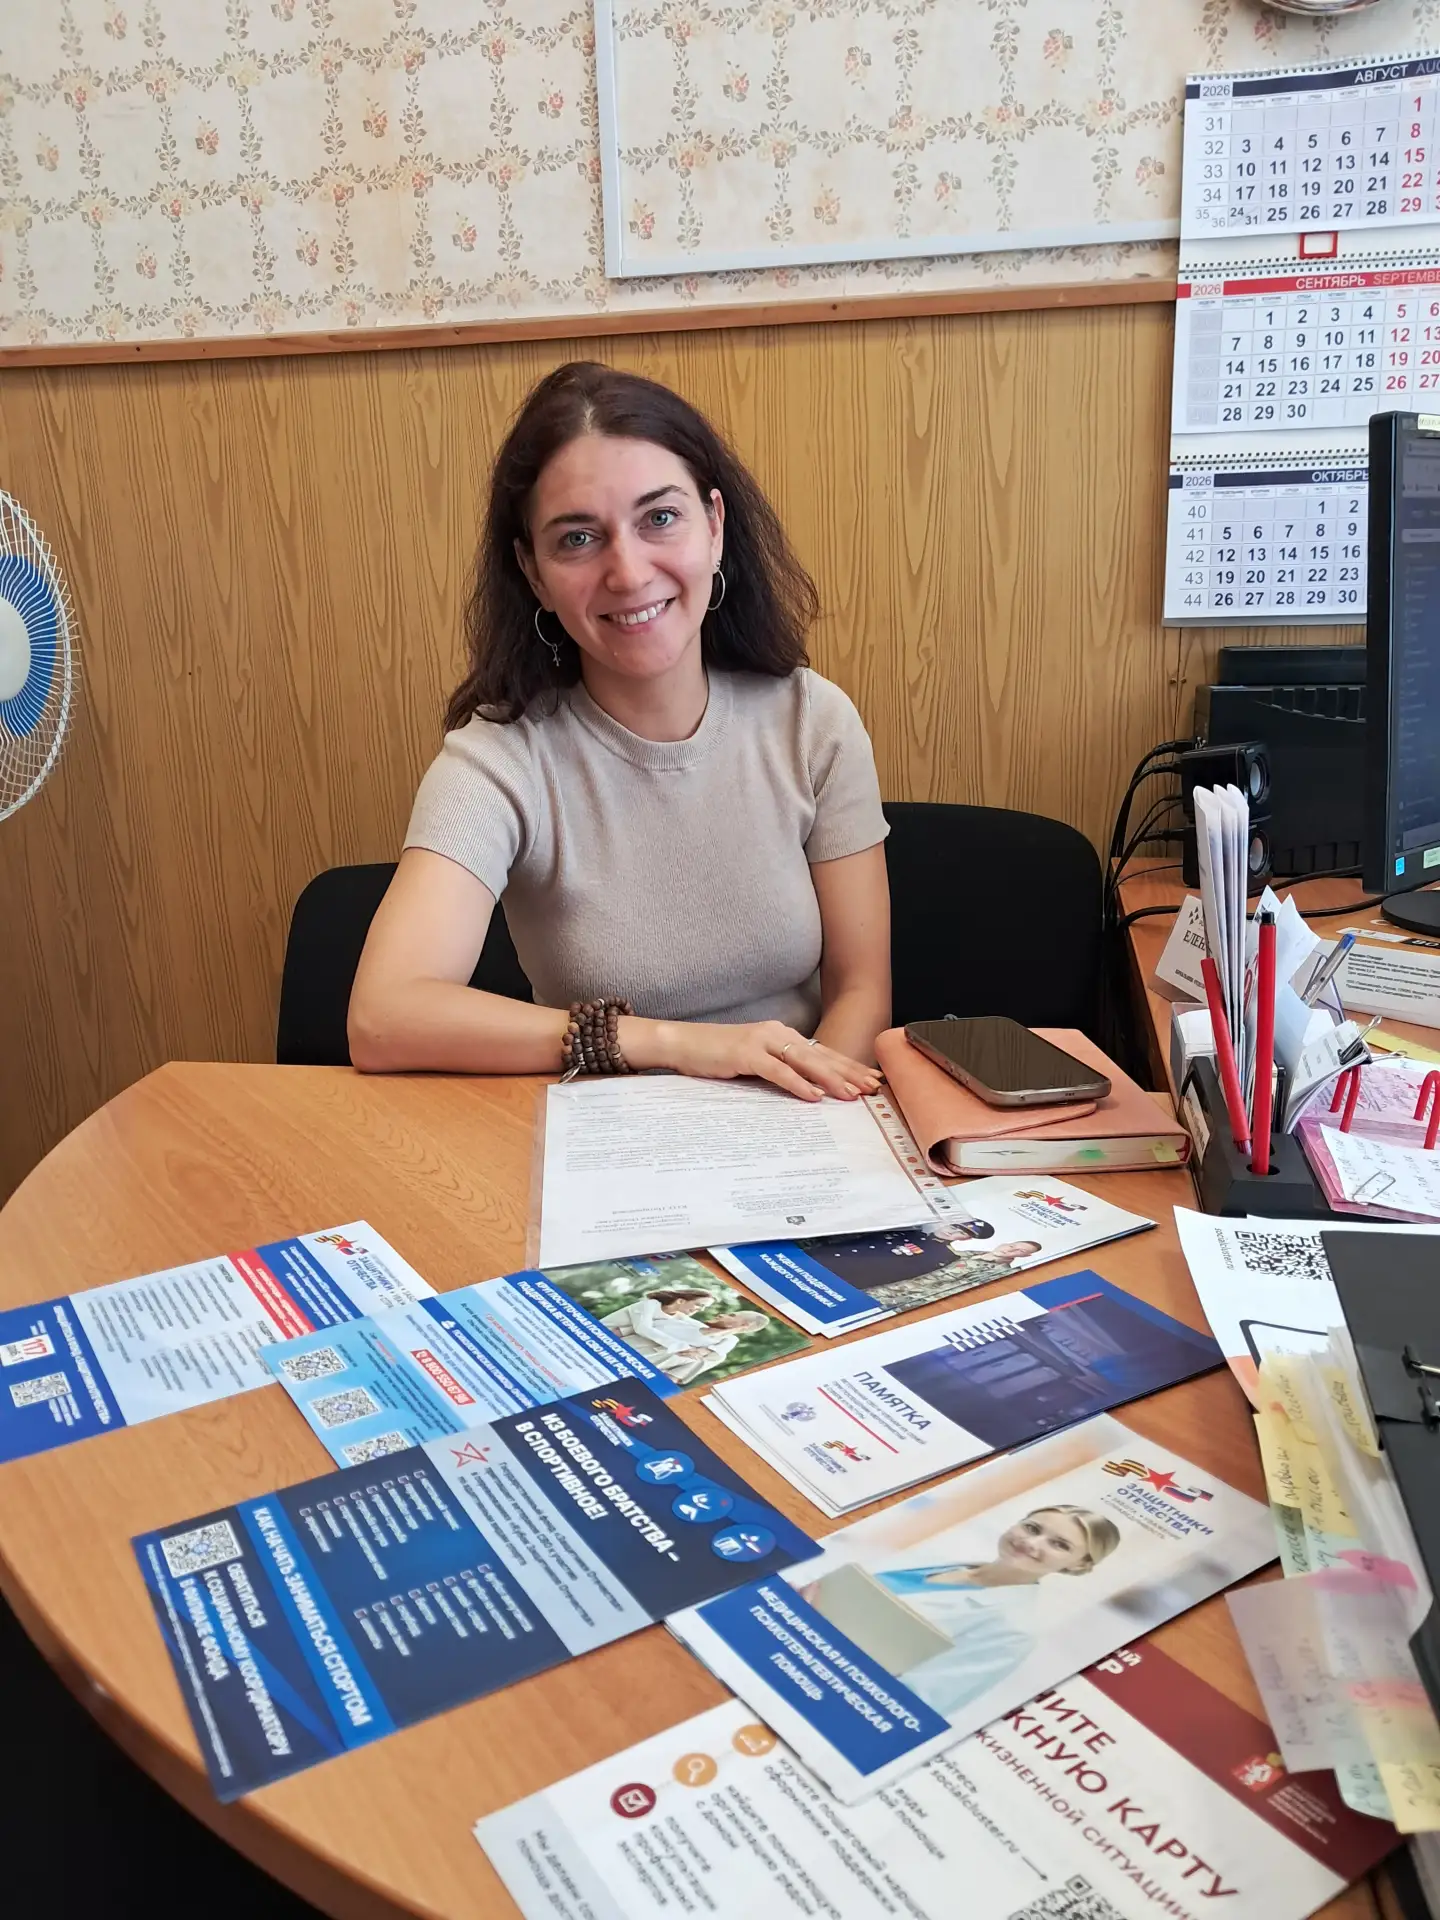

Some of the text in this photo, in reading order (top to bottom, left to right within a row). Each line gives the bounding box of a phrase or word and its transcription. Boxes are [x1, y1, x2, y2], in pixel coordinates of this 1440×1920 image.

[1354, 65, 1408, 84] АВГУСТ
[1203, 86, 1230, 96] 2026
[1206, 97, 1421, 131] 31 1
[1205, 123, 1420, 155] 32 3 4 5 6 7 8
[1204, 148, 1424, 178] 33 10 11 12 13 14 15
[1204, 173, 1422, 202] 34 17 18 19 20 21 22
[1196, 197, 1421, 221] 35 24 25 26 27 28 29
[1212, 213, 1257, 227] 36 31
[1193, 275, 1365, 296] 2026 СЕНТЯБРЬ
[1267, 303, 1439, 325] 1 2 3 4 5 6
[1232, 326, 1440, 351] 7 8 9 10 11 12 13
[1226, 350, 1440, 374] 14 15 16 17 18 19 20
[1224, 374, 1439, 398] 21 22 23 24 25 26 27
[1223, 404, 1306, 421] 28 29 30
[1186, 476, 1211, 486] 2026
[1188, 500, 1358, 518] 40 1 2
[1187, 523, 1357, 540] 41 5 6 7 8 9
[1186, 545, 1360, 562] 42 12 13 14 15 16
[1185, 568, 1358, 584] 43 19 20 21 22 23
[1184, 590, 1357, 606] 44 26 27 28 29 30
[23, 1338, 47, 1355] 117
[852, 1371, 933, 1430] ПАМЯТКА
[513, 1420, 535, 1433] В
[538, 1412, 567, 1431] ИЗ
[551, 1428, 617, 1487] БОЕВОГО
[519, 1430, 609, 1520] СПОРТИВНОЕ!
[600, 1482, 677, 1554] БРАТСТВА
[1115, 1487, 1191, 1535] ОТЕЧЕСТВА
[1125, 1482, 1214, 1537] ЗАЩИТНИКИ
[225, 1561, 266, 1628] ОБРАТИТЬСЯ
[177, 1577, 230, 1682] В ФИЛИАЛЕ ФОНДА
[251, 1507, 372, 1727] КАК НАЧАТЬ ЗАНИМАТЬСЯ СПОРТОМ
[201, 1569, 292, 1761] К СОЦИАЛЬНОМУ КООРДИНАТОРУ
[748, 1604, 894, 1733] ПСИХОТЕРАПЕВТИЧЕСКАЯ
[754, 1585, 925, 1734] МЕДИЦИНСКАЯ И ПСИХОЛОГО-
[768, 1651, 827, 1702] ПОМОЩЬ
[976, 1730, 1088, 1826] ЖИЗНЕННОЙ
[894, 1787, 929, 1819] виды
[930, 1770, 1020, 1854] socialcluster.ru
[1107, 1796, 1239, 1899] КАРТУ
